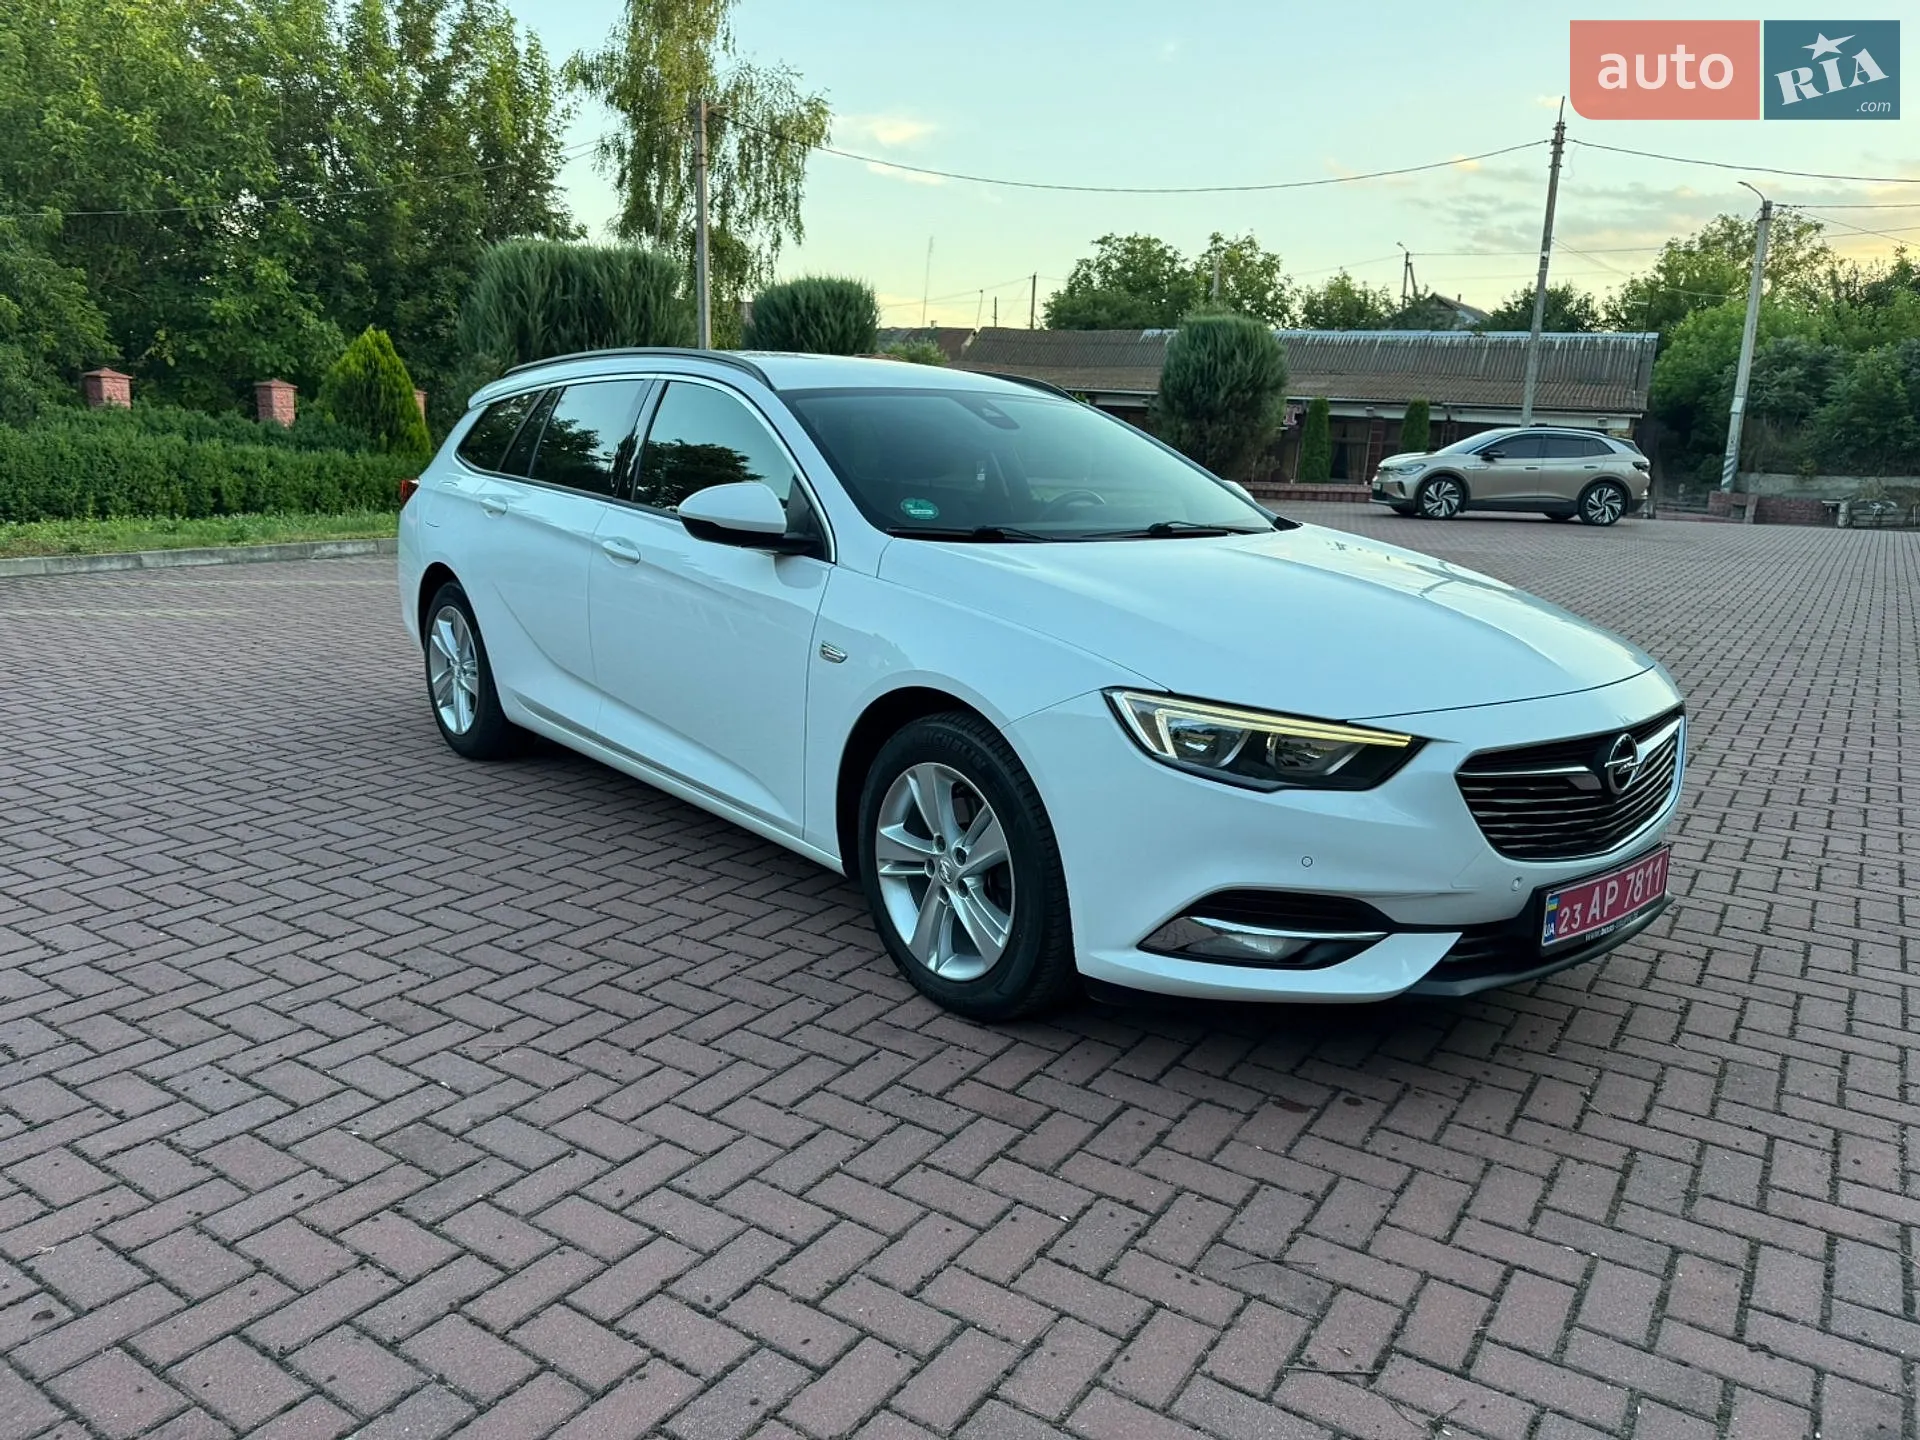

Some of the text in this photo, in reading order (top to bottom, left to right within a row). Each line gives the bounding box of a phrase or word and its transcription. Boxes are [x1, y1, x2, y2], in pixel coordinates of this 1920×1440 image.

[1558, 902, 1583, 934] 23
[1586, 880, 1619, 924] AP
[1623, 857, 1664, 909] 7811
